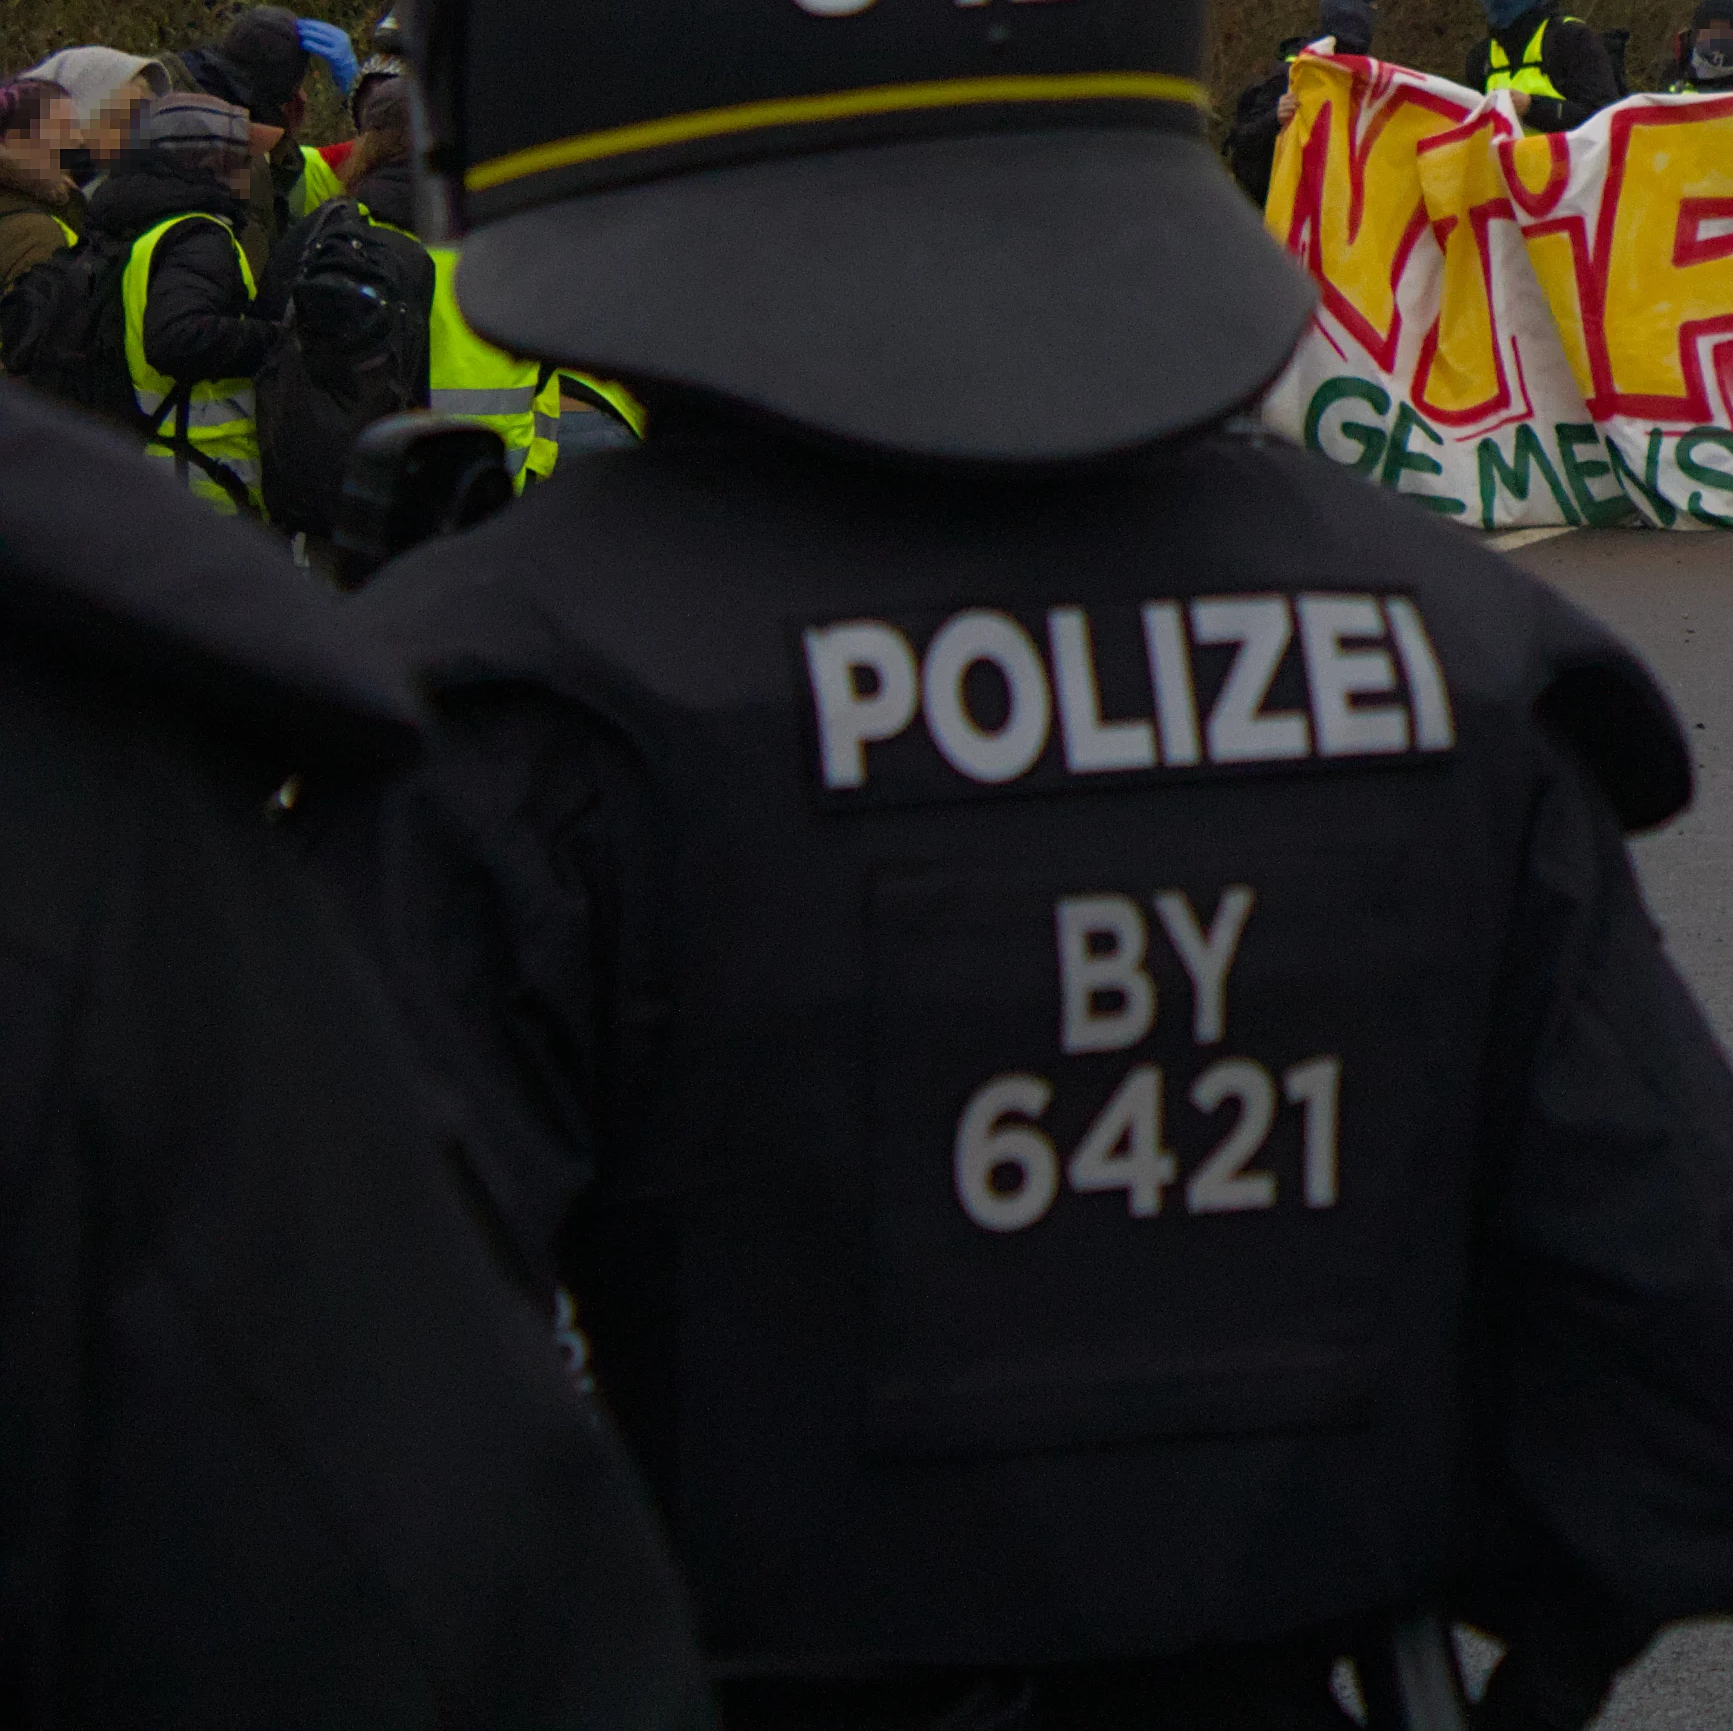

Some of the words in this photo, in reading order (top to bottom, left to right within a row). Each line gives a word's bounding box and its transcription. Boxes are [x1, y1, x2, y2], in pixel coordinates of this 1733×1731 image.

[802, 591, 1456, 790] POLIZEI
[1055, 883, 1256, 1056] BY
[952, 1053, 1343, 1234] 6421
